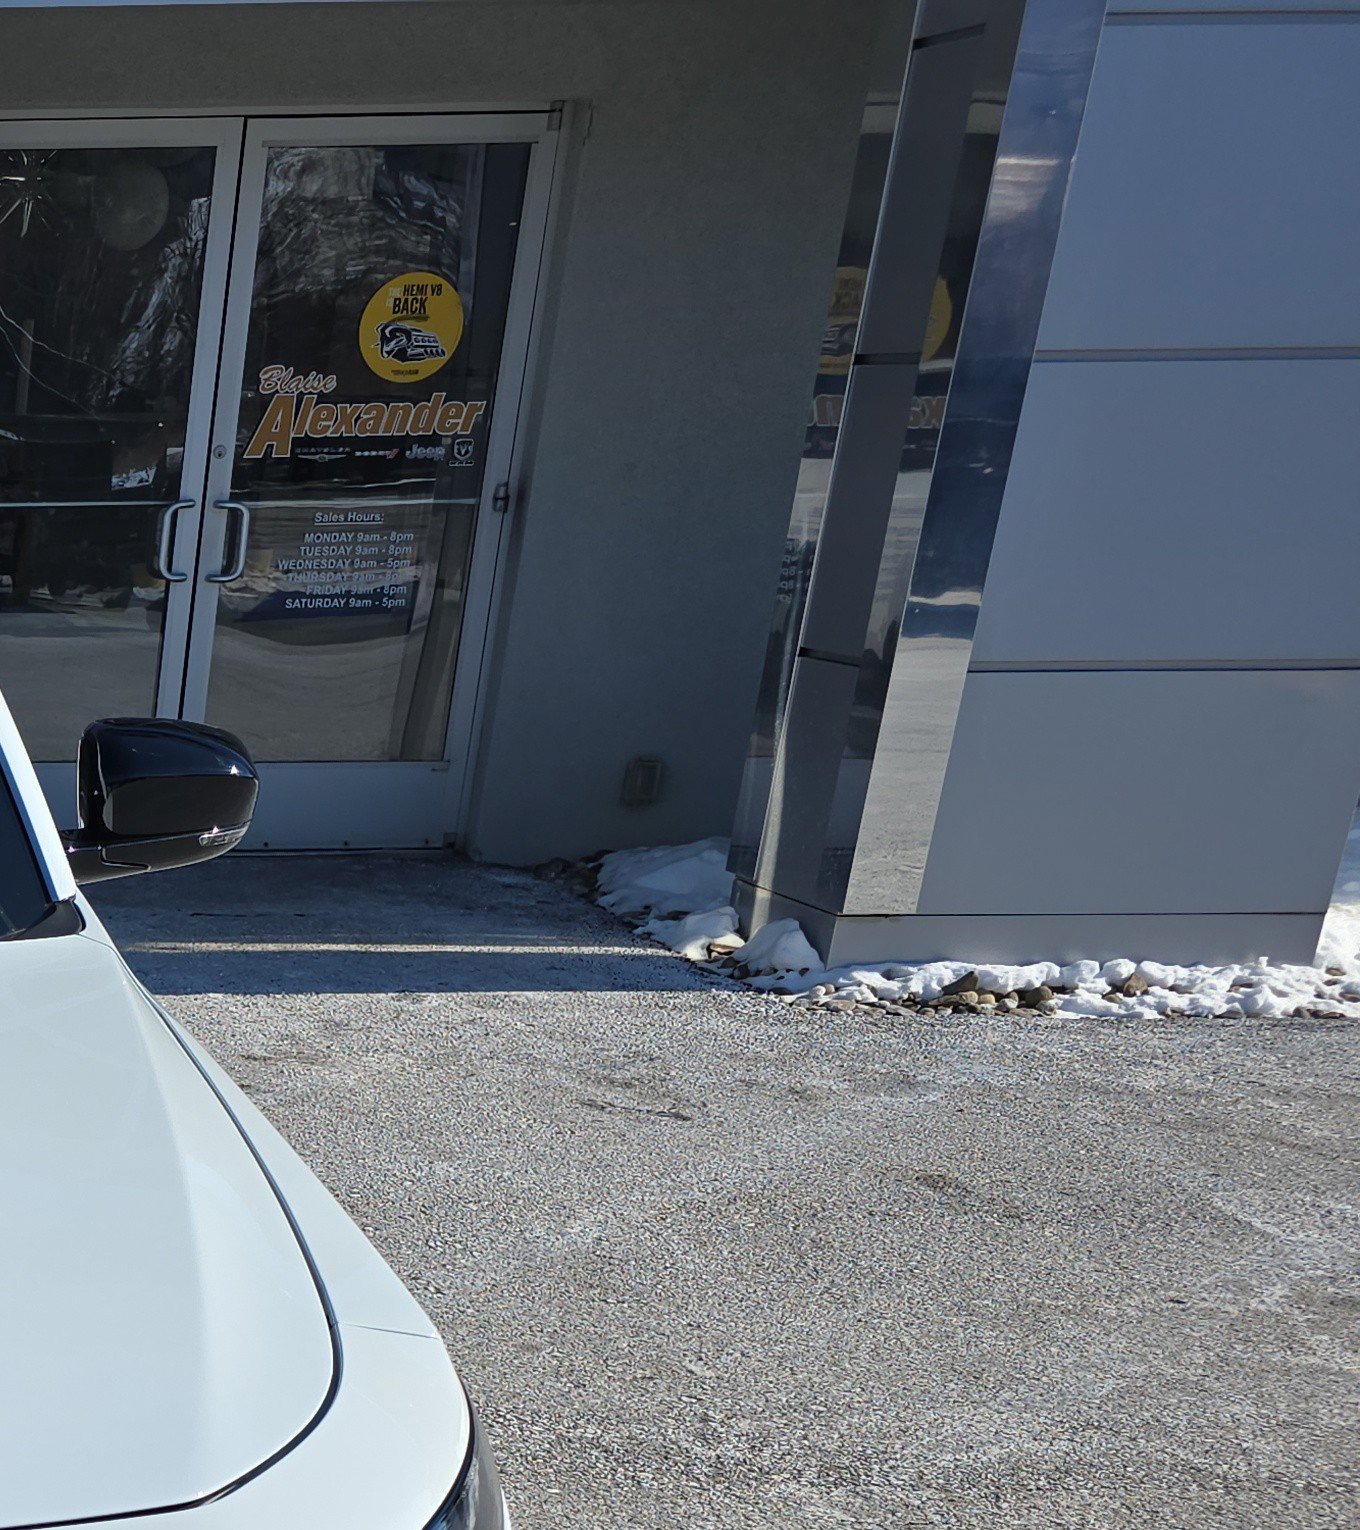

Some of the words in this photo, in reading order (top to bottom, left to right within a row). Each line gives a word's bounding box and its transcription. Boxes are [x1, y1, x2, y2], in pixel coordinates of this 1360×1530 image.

[403, 284, 428, 297] HEMI
[431, 283, 443, 296] V8
[392, 297, 428, 315] BACK
[259, 365, 336, 394] Blaise
[243, 392, 487, 459] Alexander
[314, 512, 345, 522] Sales
[347, 511, 384, 522] Hours:
[304, 532, 354, 543] MONDAY
[357, 533, 380, 542] 9am
[389, 532, 413, 543] 8pm
[300, 546, 353, 556] TUESDAY
[355, 546, 378, 555] 9am
[388, 545, 412, 556] 8pm
[278, 559, 351, 569] WEDNESDAY
[353, 558, 377, 568] 9am
[386, 558, 411, 569] 5pm
[287, 572, 349, 583] THURSDAY
[352, 572, 375, 581] 9am
[305, 585, 347, 595] FRIDAY
[285, 598, 346, 609] SATURDAY
[349, 597, 372, 608] 9am
[381, 597, 406, 608] 5pm
